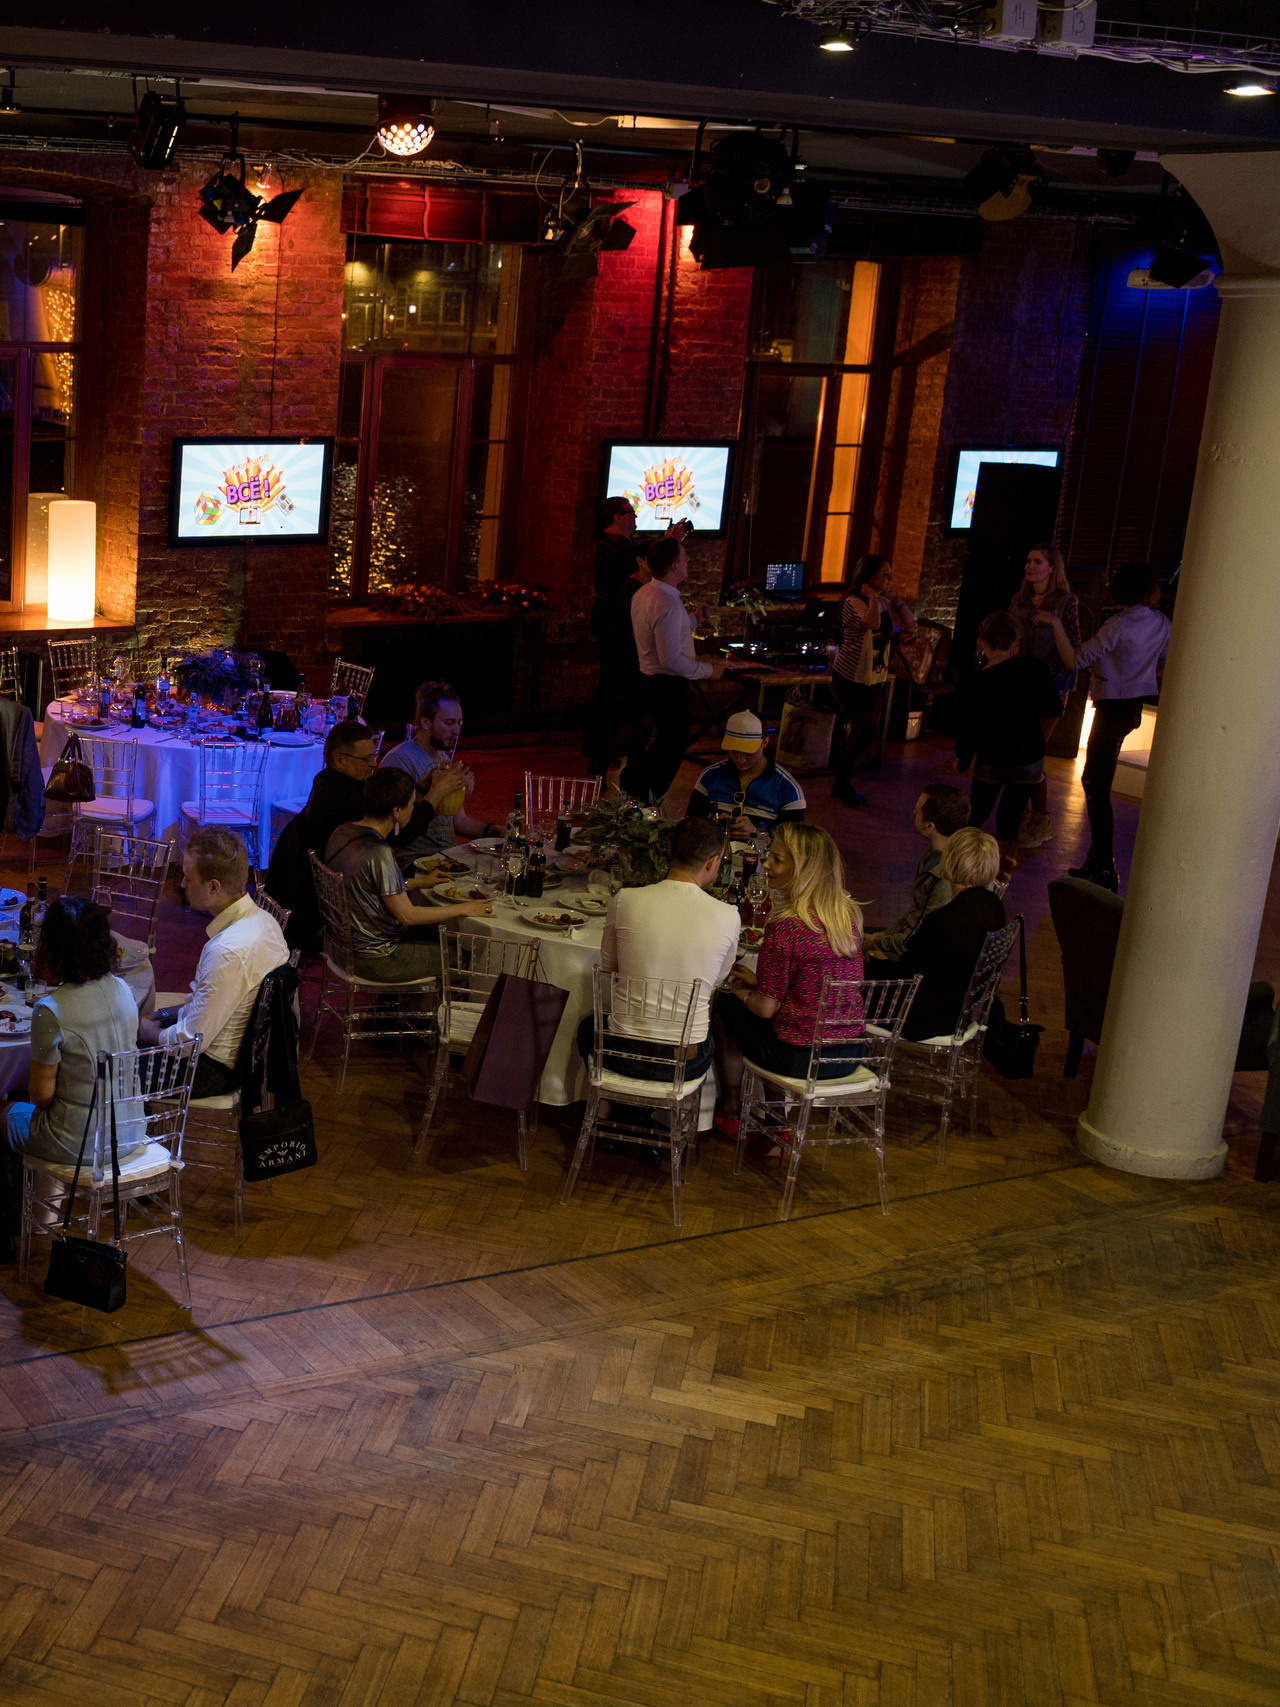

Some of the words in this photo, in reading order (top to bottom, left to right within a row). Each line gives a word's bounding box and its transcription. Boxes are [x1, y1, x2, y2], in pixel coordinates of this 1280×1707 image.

[1013, 2, 1025, 28] 14
[257, 1140, 307, 1161] EMPORIO
[258, 1149, 307, 1168] ARMANI
